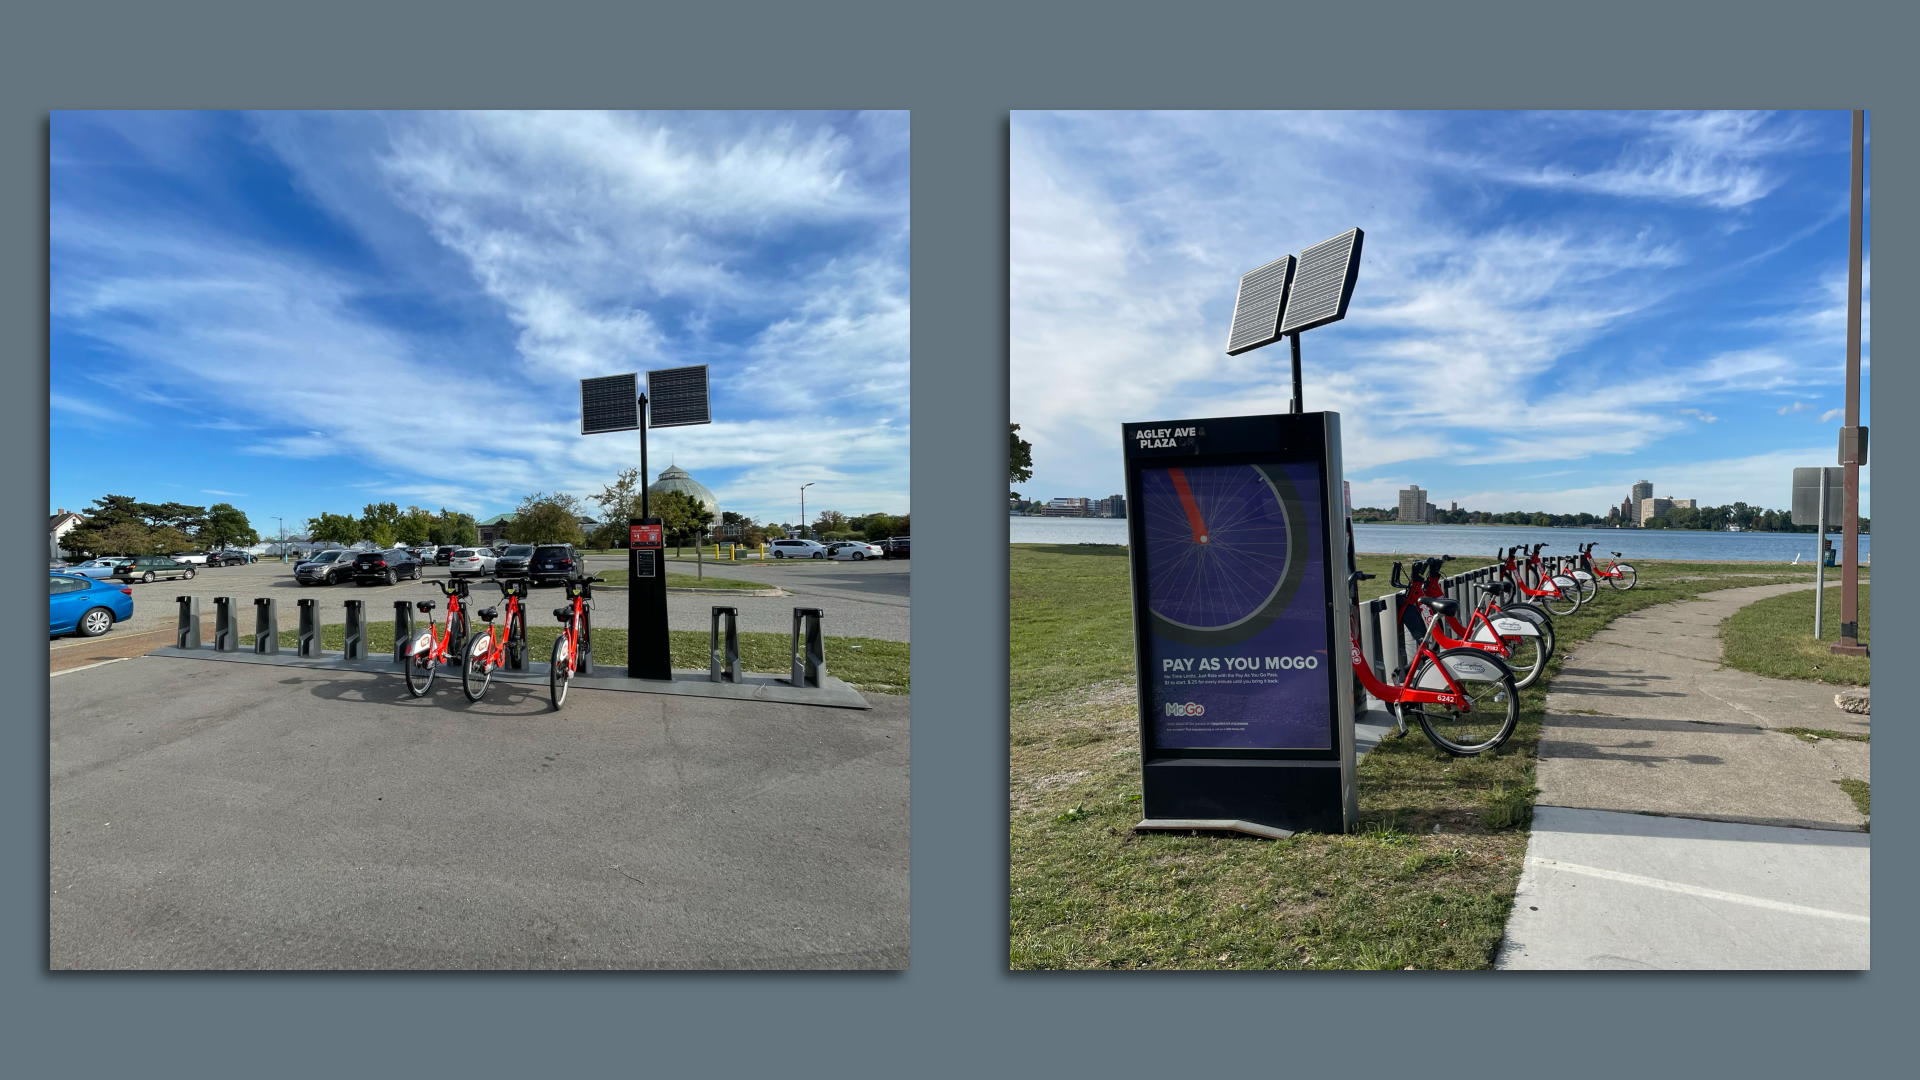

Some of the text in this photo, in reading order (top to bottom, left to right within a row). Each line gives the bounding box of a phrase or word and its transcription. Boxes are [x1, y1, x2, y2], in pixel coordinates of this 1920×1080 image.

[1174, 427, 1196, 437] AVE
[1140, 438, 1177, 449] PLAZA
[1162, 656, 1318, 671] PAY AS YOU MOGO
[1437, 694, 1454, 702] 6242
[1165, 702, 1204, 716] MoGo
